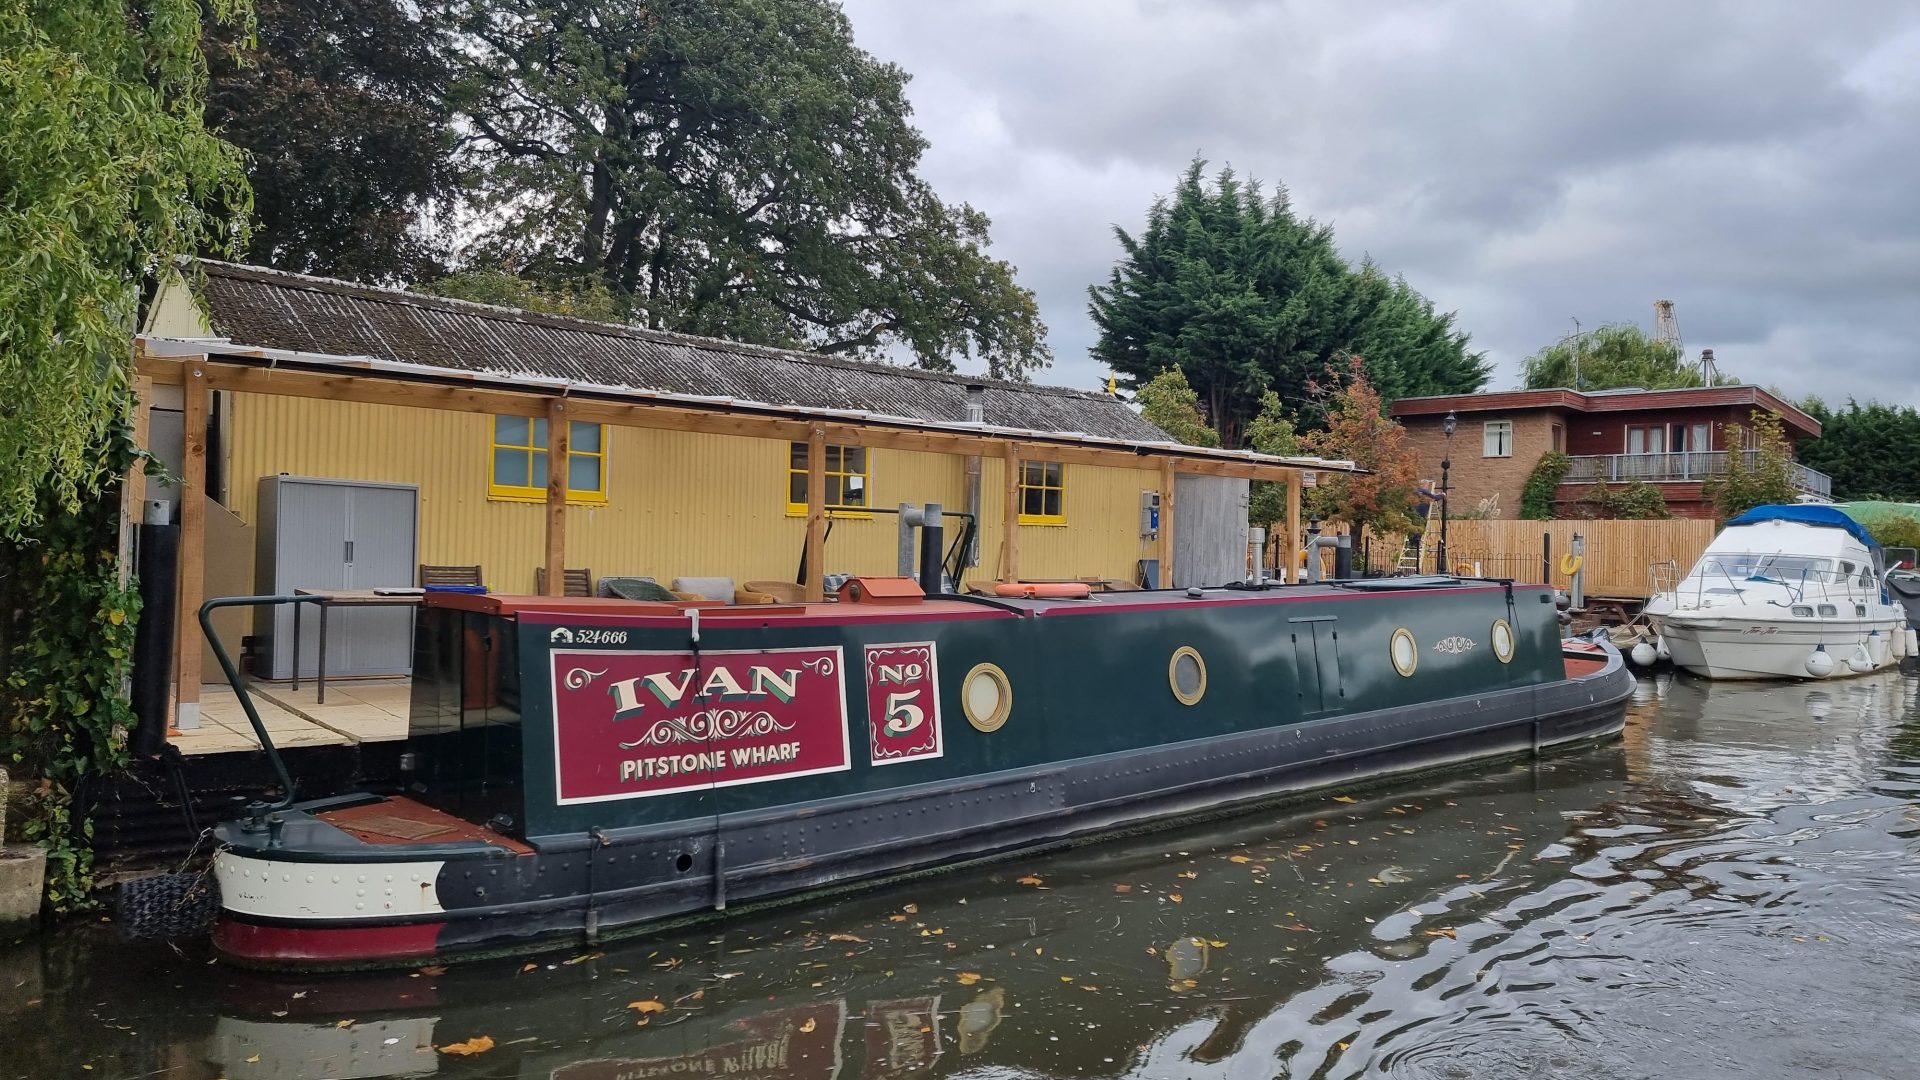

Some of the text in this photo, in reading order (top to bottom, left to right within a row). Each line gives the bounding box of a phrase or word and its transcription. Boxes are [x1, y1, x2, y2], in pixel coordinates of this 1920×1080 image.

[576, 629, 627, 644] 524666
[608, 665, 802, 719] IVAN
[885, 689, 924, 736] 5
[621, 742, 801, 782] PITSTONE WHARF
